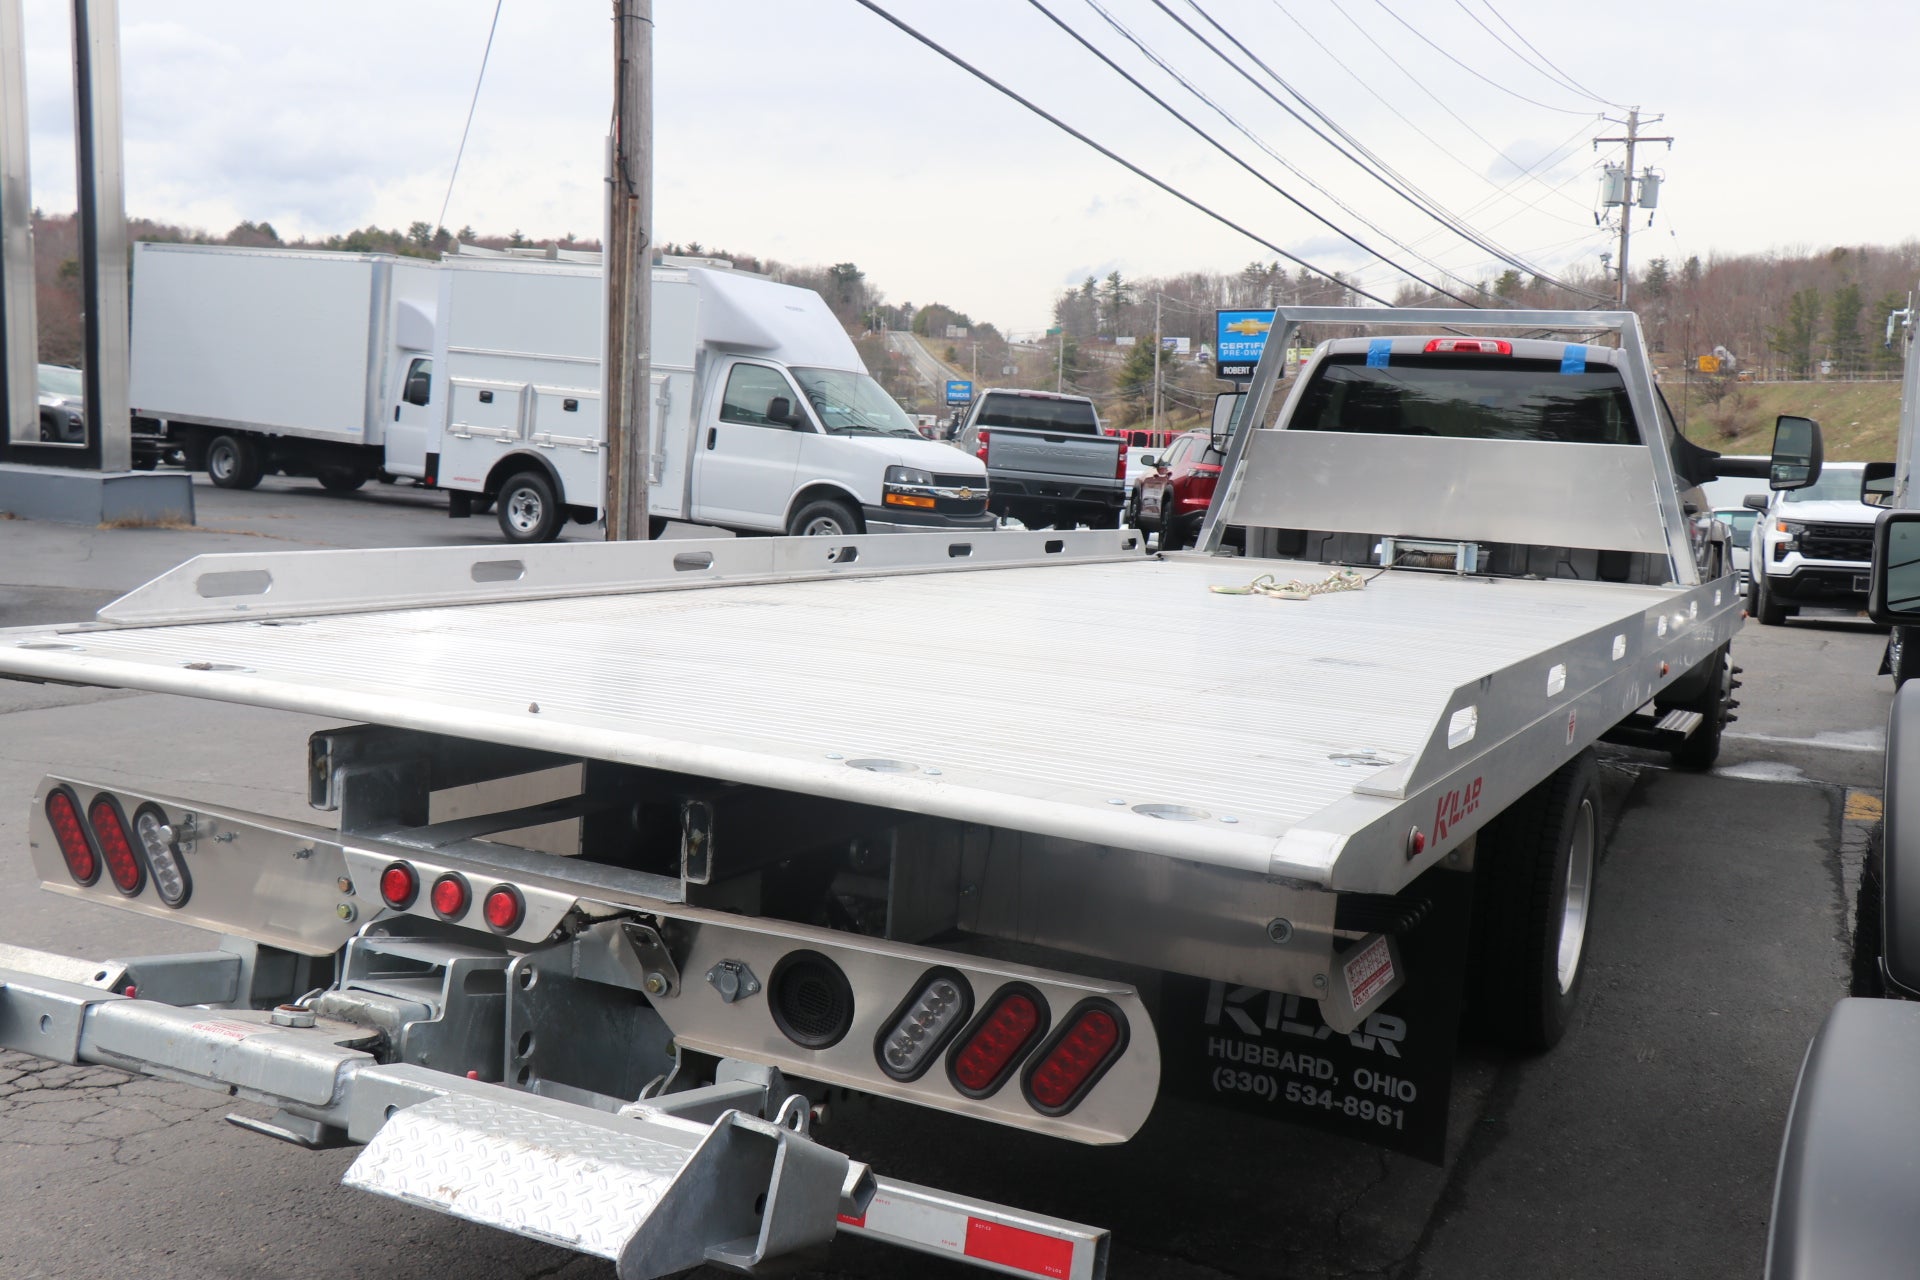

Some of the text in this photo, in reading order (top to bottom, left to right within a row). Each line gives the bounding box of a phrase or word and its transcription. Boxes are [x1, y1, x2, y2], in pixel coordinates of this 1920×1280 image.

[1223, 366, 1250, 375] ROBERT
[1208, 1036, 1417, 1103] HUBBARD, OHIO
[1212, 1066, 1405, 1130] (330) 534-8961
